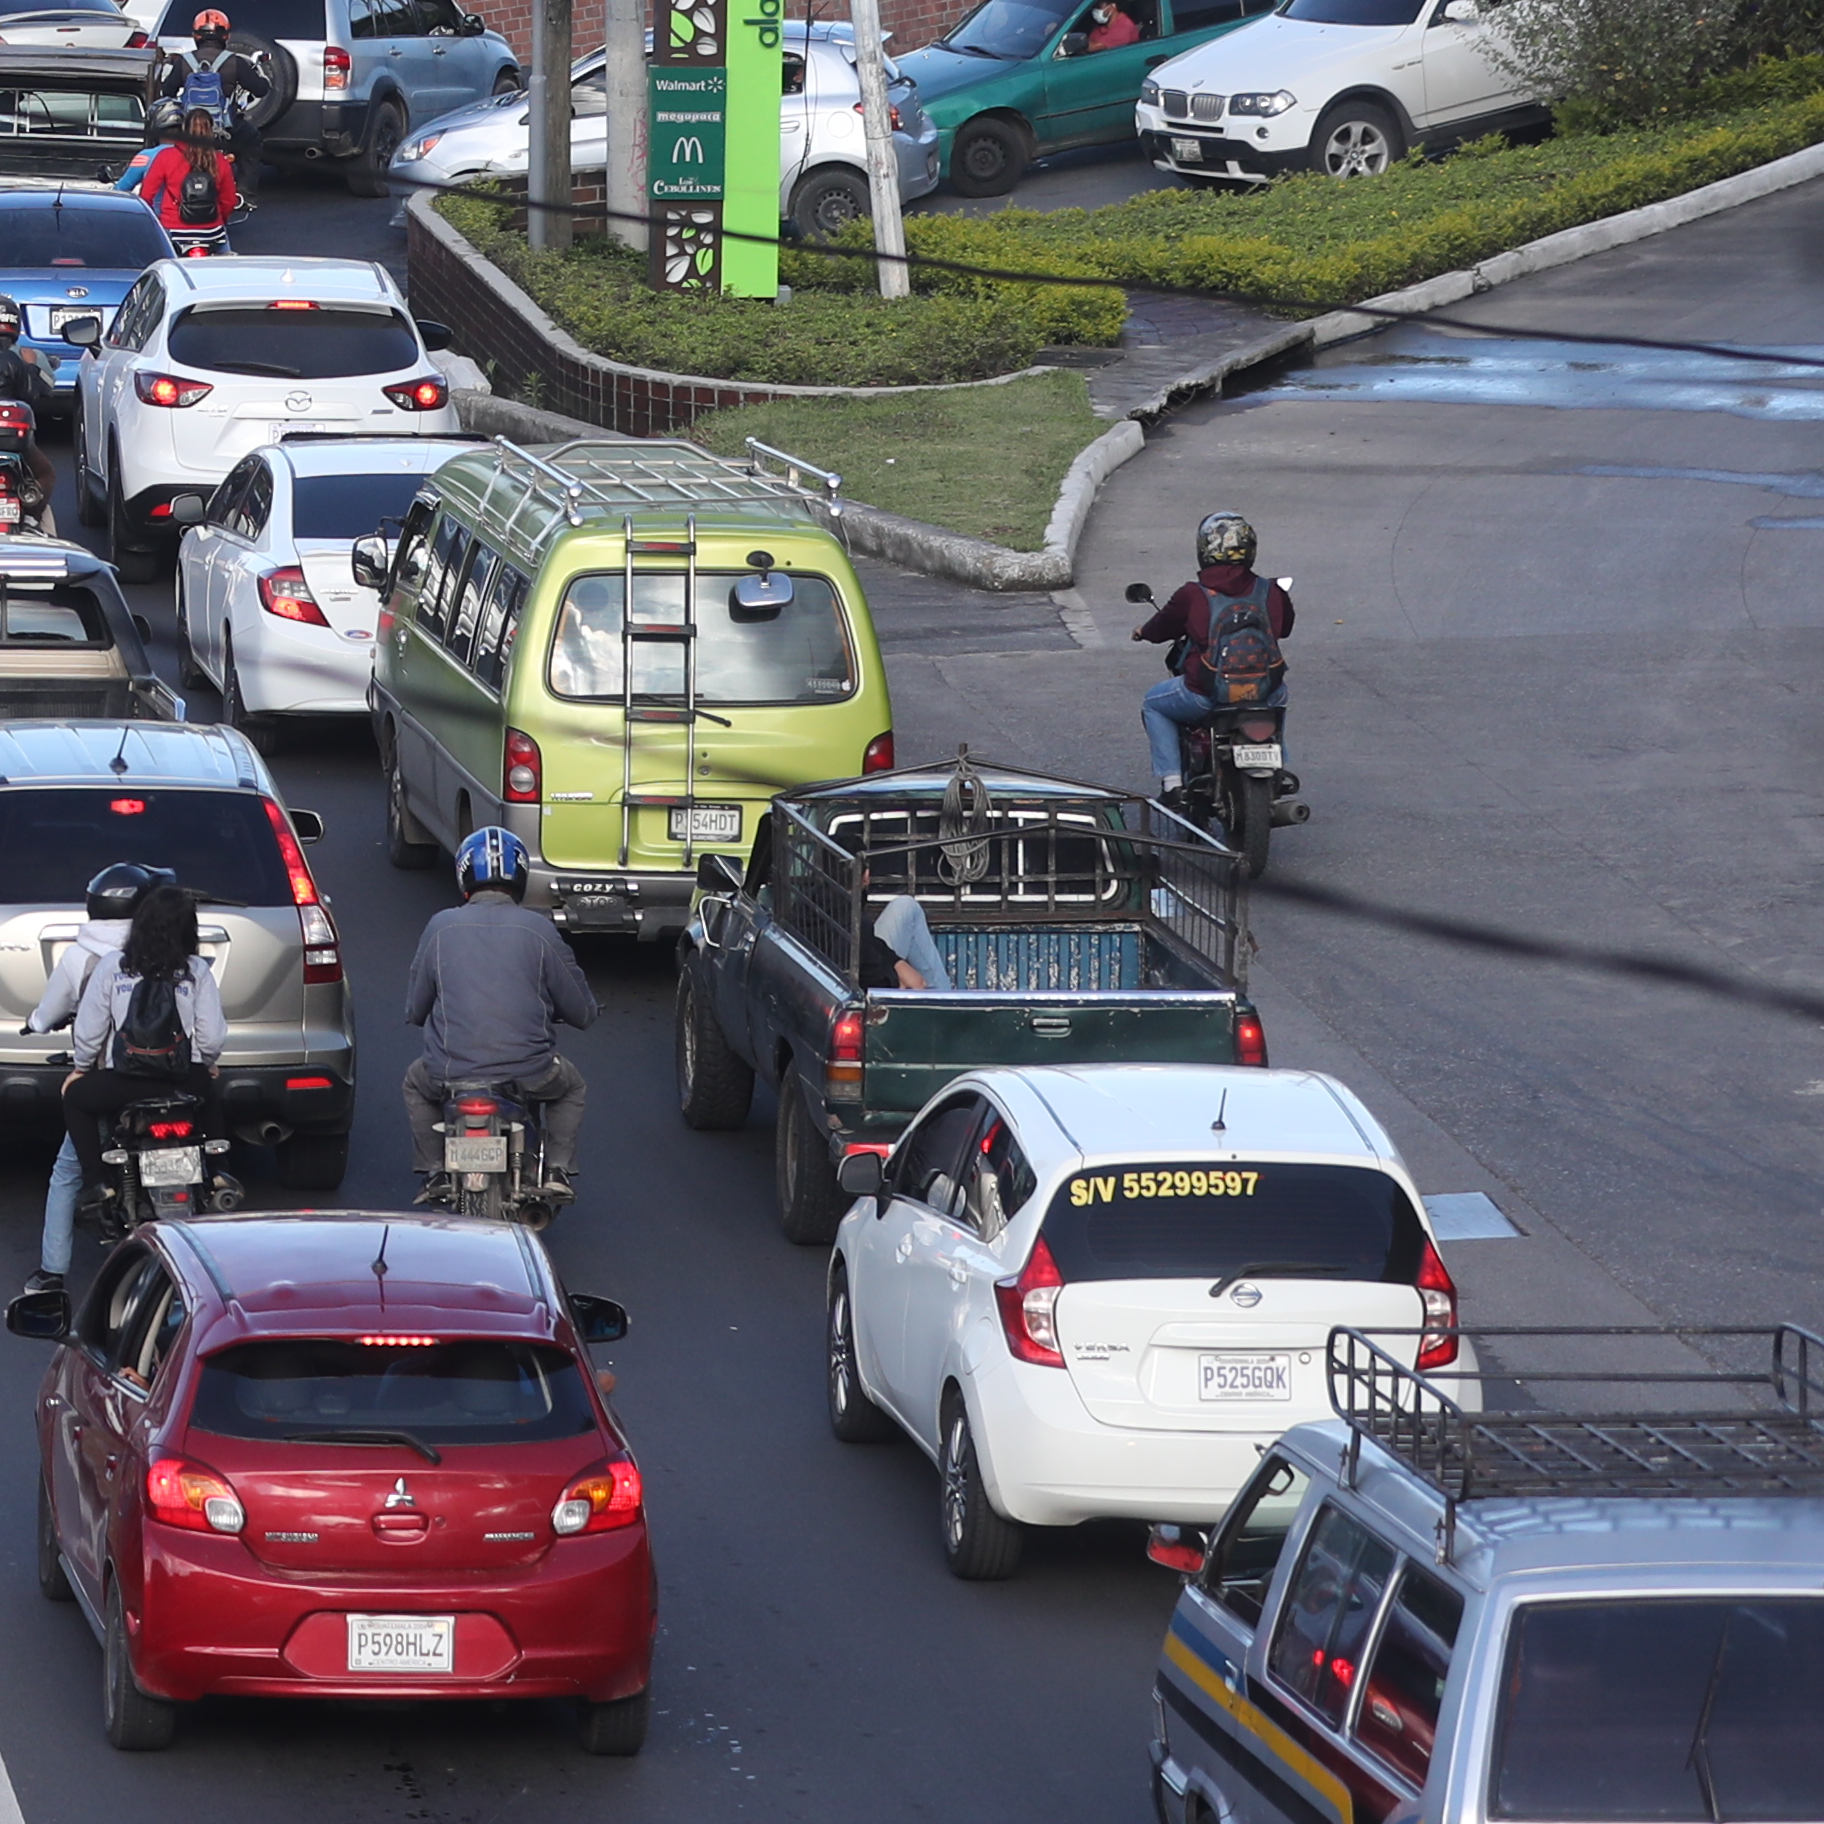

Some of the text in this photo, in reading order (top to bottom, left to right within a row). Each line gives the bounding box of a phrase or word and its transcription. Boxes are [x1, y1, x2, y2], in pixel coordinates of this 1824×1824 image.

[656, 78, 706, 92] Walmart
[674, 811, 736, 833] P54HDT
[1070, 1171, 1259, 1207] S/V 55299597
[1204, 1365, 1287, 1389] P525GQK
[357, 1632, 444, 1658] P598HLZ
